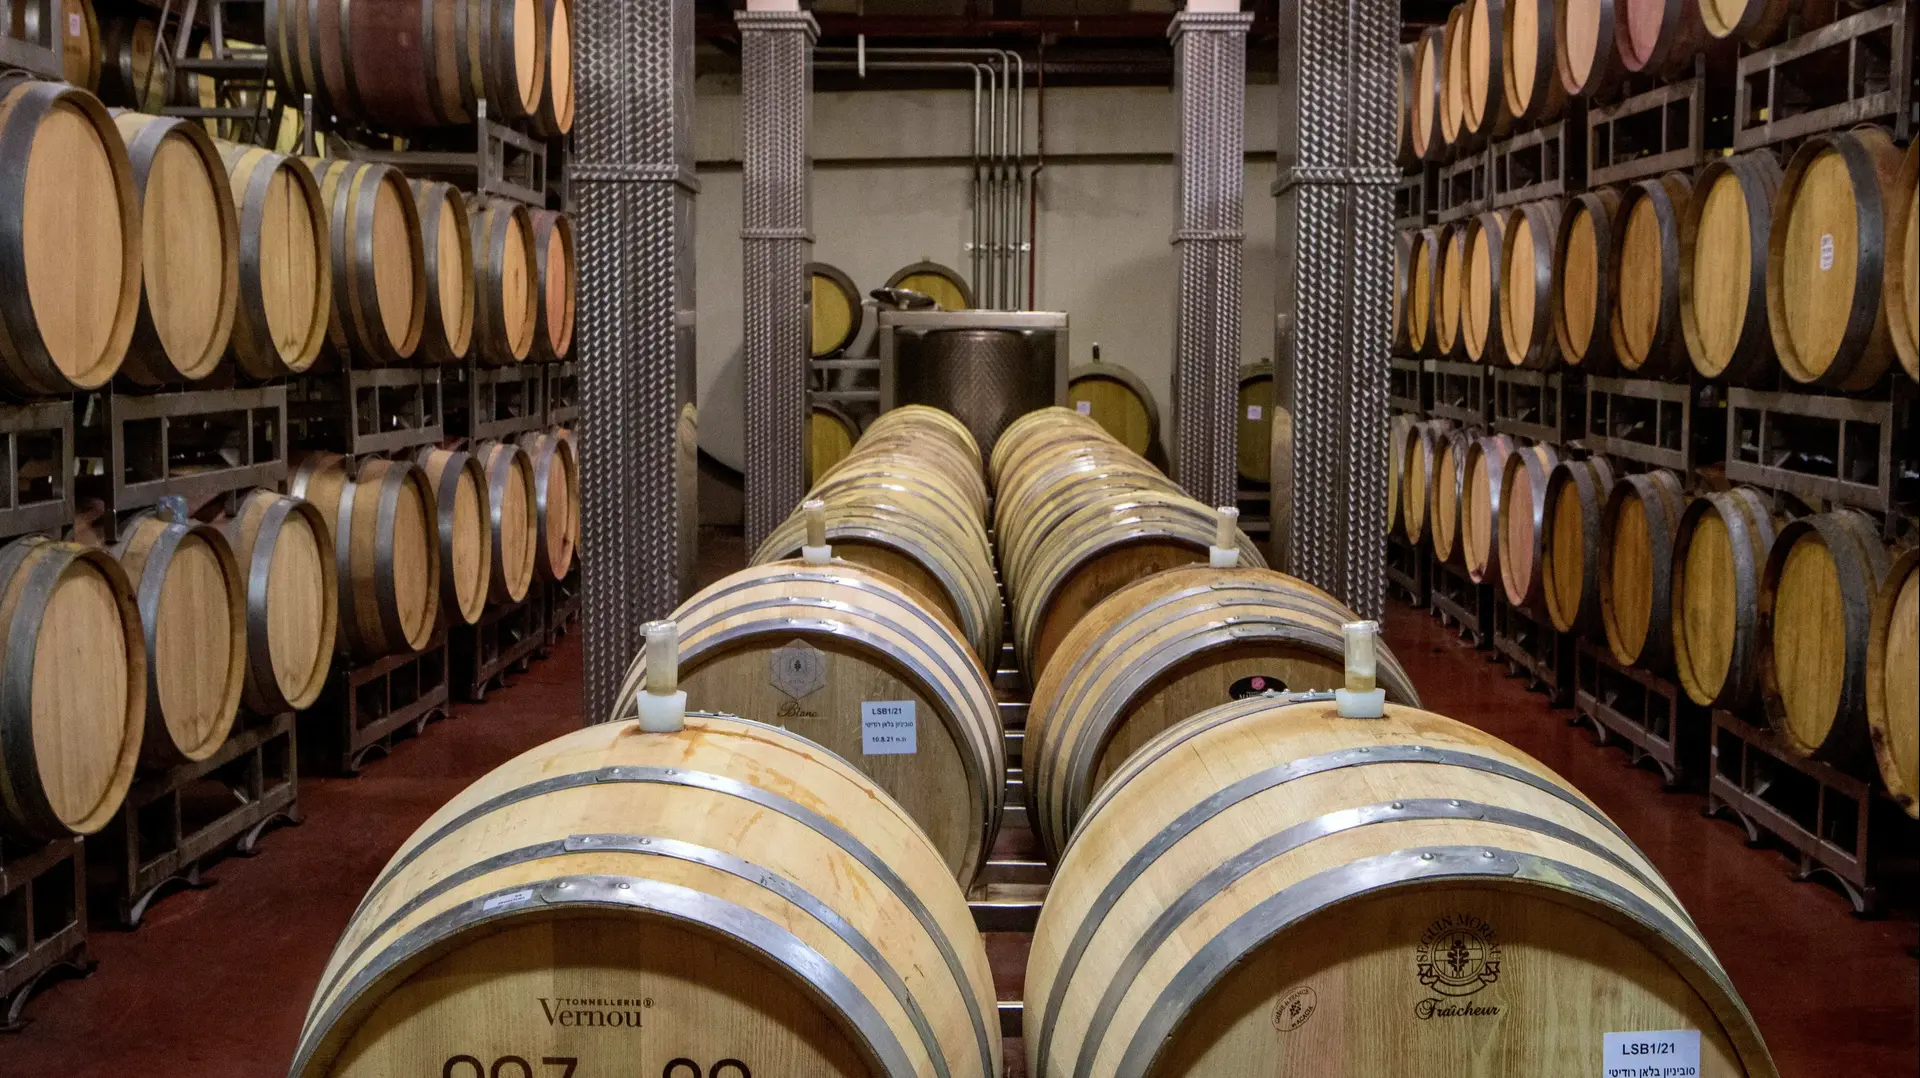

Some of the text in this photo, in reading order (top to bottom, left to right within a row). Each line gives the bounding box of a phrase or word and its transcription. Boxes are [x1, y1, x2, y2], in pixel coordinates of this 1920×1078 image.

[777, 701, 819, 717] Blanc
[1417, 913, 1501, 962] SEGUIN MOREAU
[537, 998, 643, 1028] Vernou
[1415, 998, 1500, 1020] Fraîcheur
[1622, 1042, 1675, 1055] LSB1/21
[1608, 1066, 1696, 1078] סוביניון בלאן רודיטי
